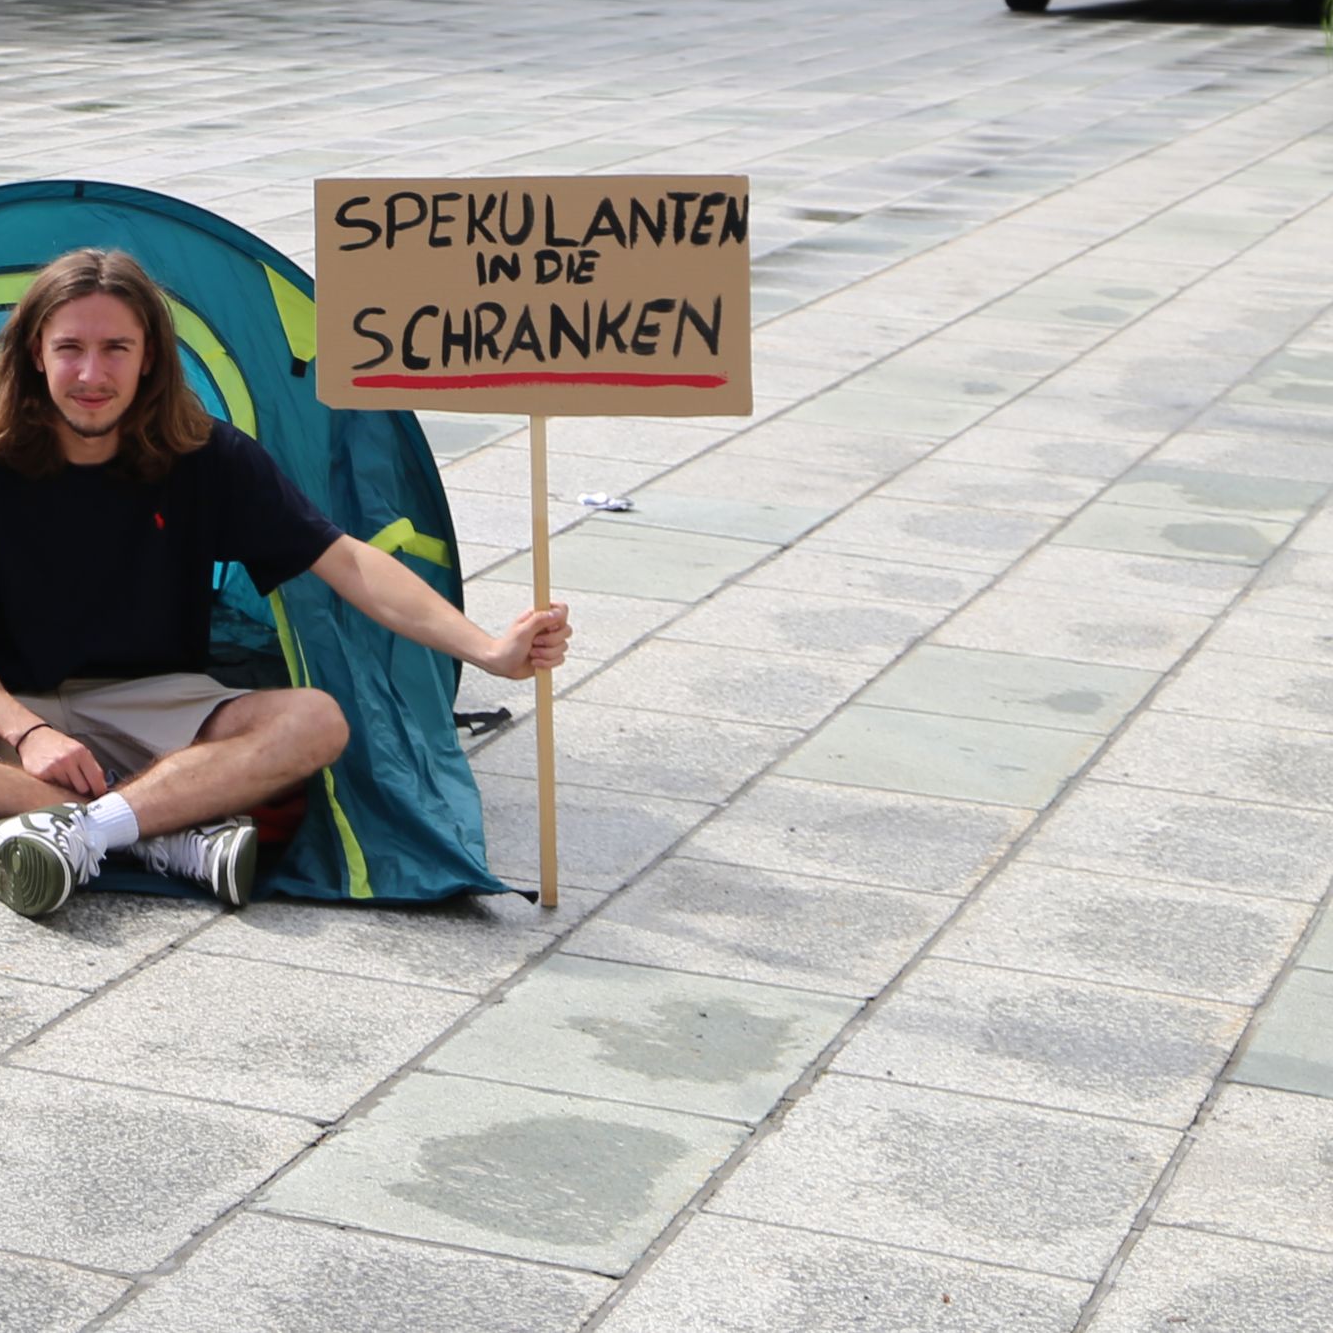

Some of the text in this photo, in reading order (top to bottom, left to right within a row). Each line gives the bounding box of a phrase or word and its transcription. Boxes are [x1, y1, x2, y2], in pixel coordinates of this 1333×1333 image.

[334, 191, 750, 253] SPEKULANTEN
[476, 249, 601, 287] IN DIE
[351, 295, 724, 371] SCHRANKEN
